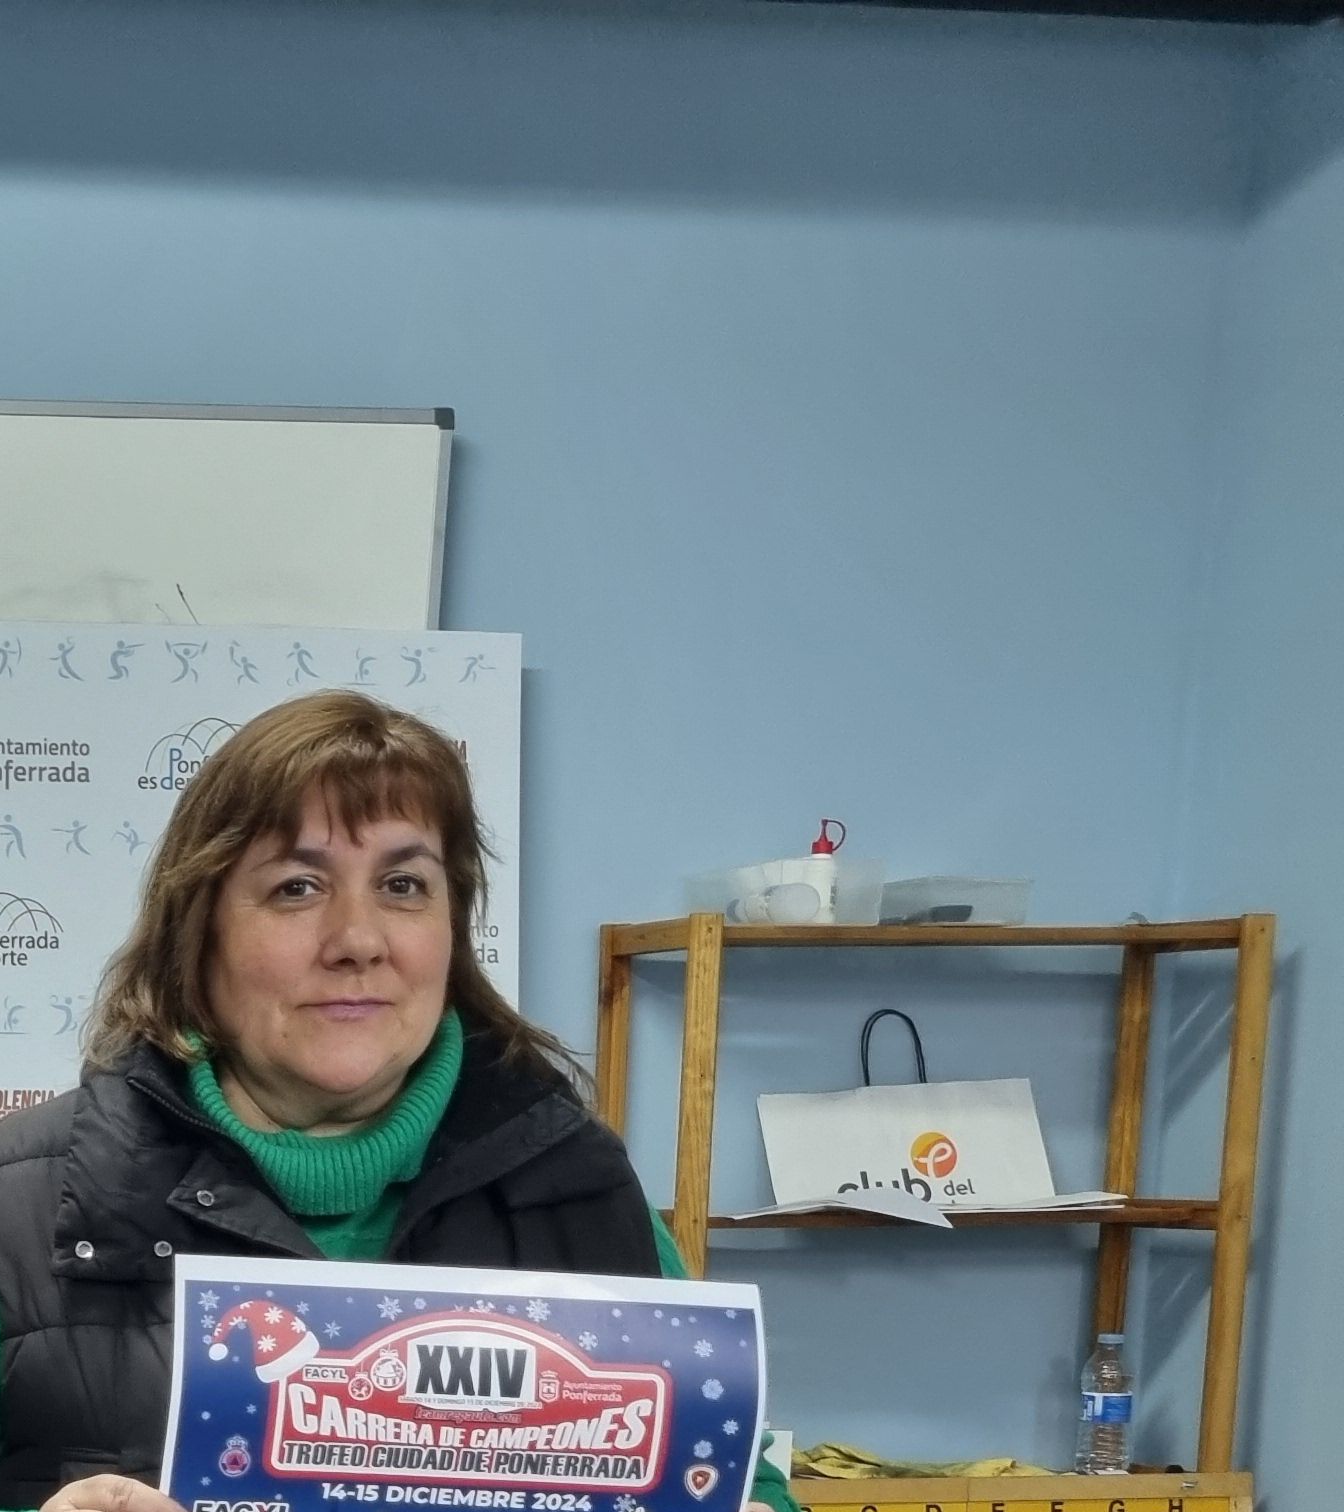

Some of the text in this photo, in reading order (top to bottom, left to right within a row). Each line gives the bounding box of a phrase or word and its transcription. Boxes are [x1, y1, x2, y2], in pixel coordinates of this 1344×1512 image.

[138, 775, 157, 790] es
[944, 1179, 975, 1196] del
[305, 1368, 347, 1380] FACYL
[416, 1344, 527, 1398] XXIV
[562, 1391, 622, 1404] Ponferrada
[288, 1384, 653, 1450] CARRERA DE CAMPEONES
[284, 1443, 643, 1480] TROFEO CIUDAD DE PONFERRADA
[322, 1483, 592, 1512] 14-15 DICIEMBRE 2024
